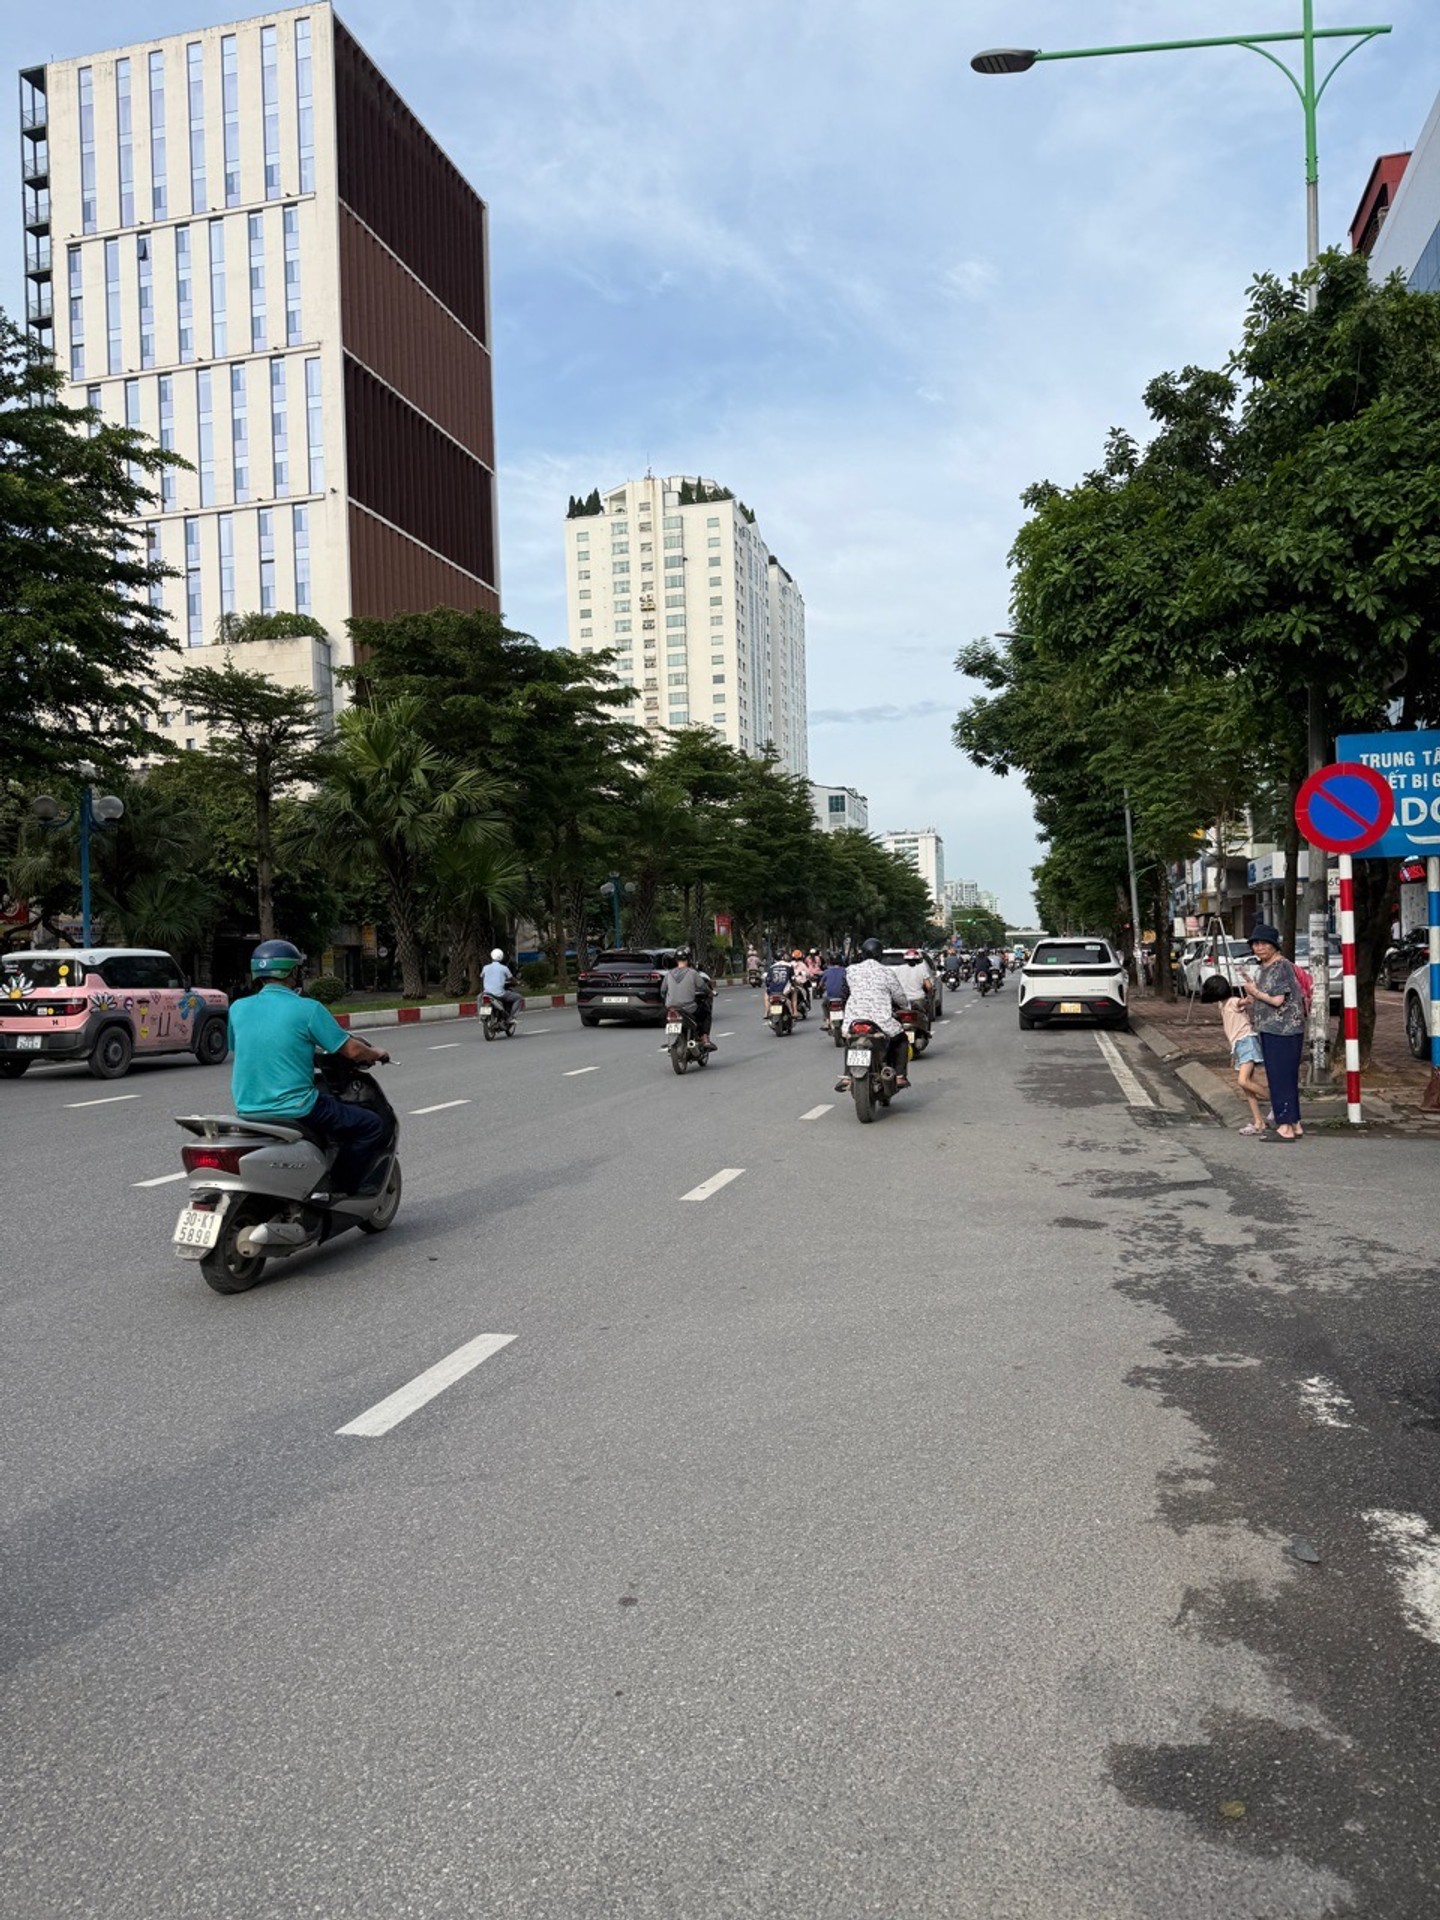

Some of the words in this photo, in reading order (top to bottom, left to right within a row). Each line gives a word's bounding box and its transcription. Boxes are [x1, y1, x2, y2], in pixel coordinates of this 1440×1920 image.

[1360, 751, 1416, 769] TRUNG
[1412, 773, 1428, 791] BỊ
[179, 1227, 211, 1245] 5898
